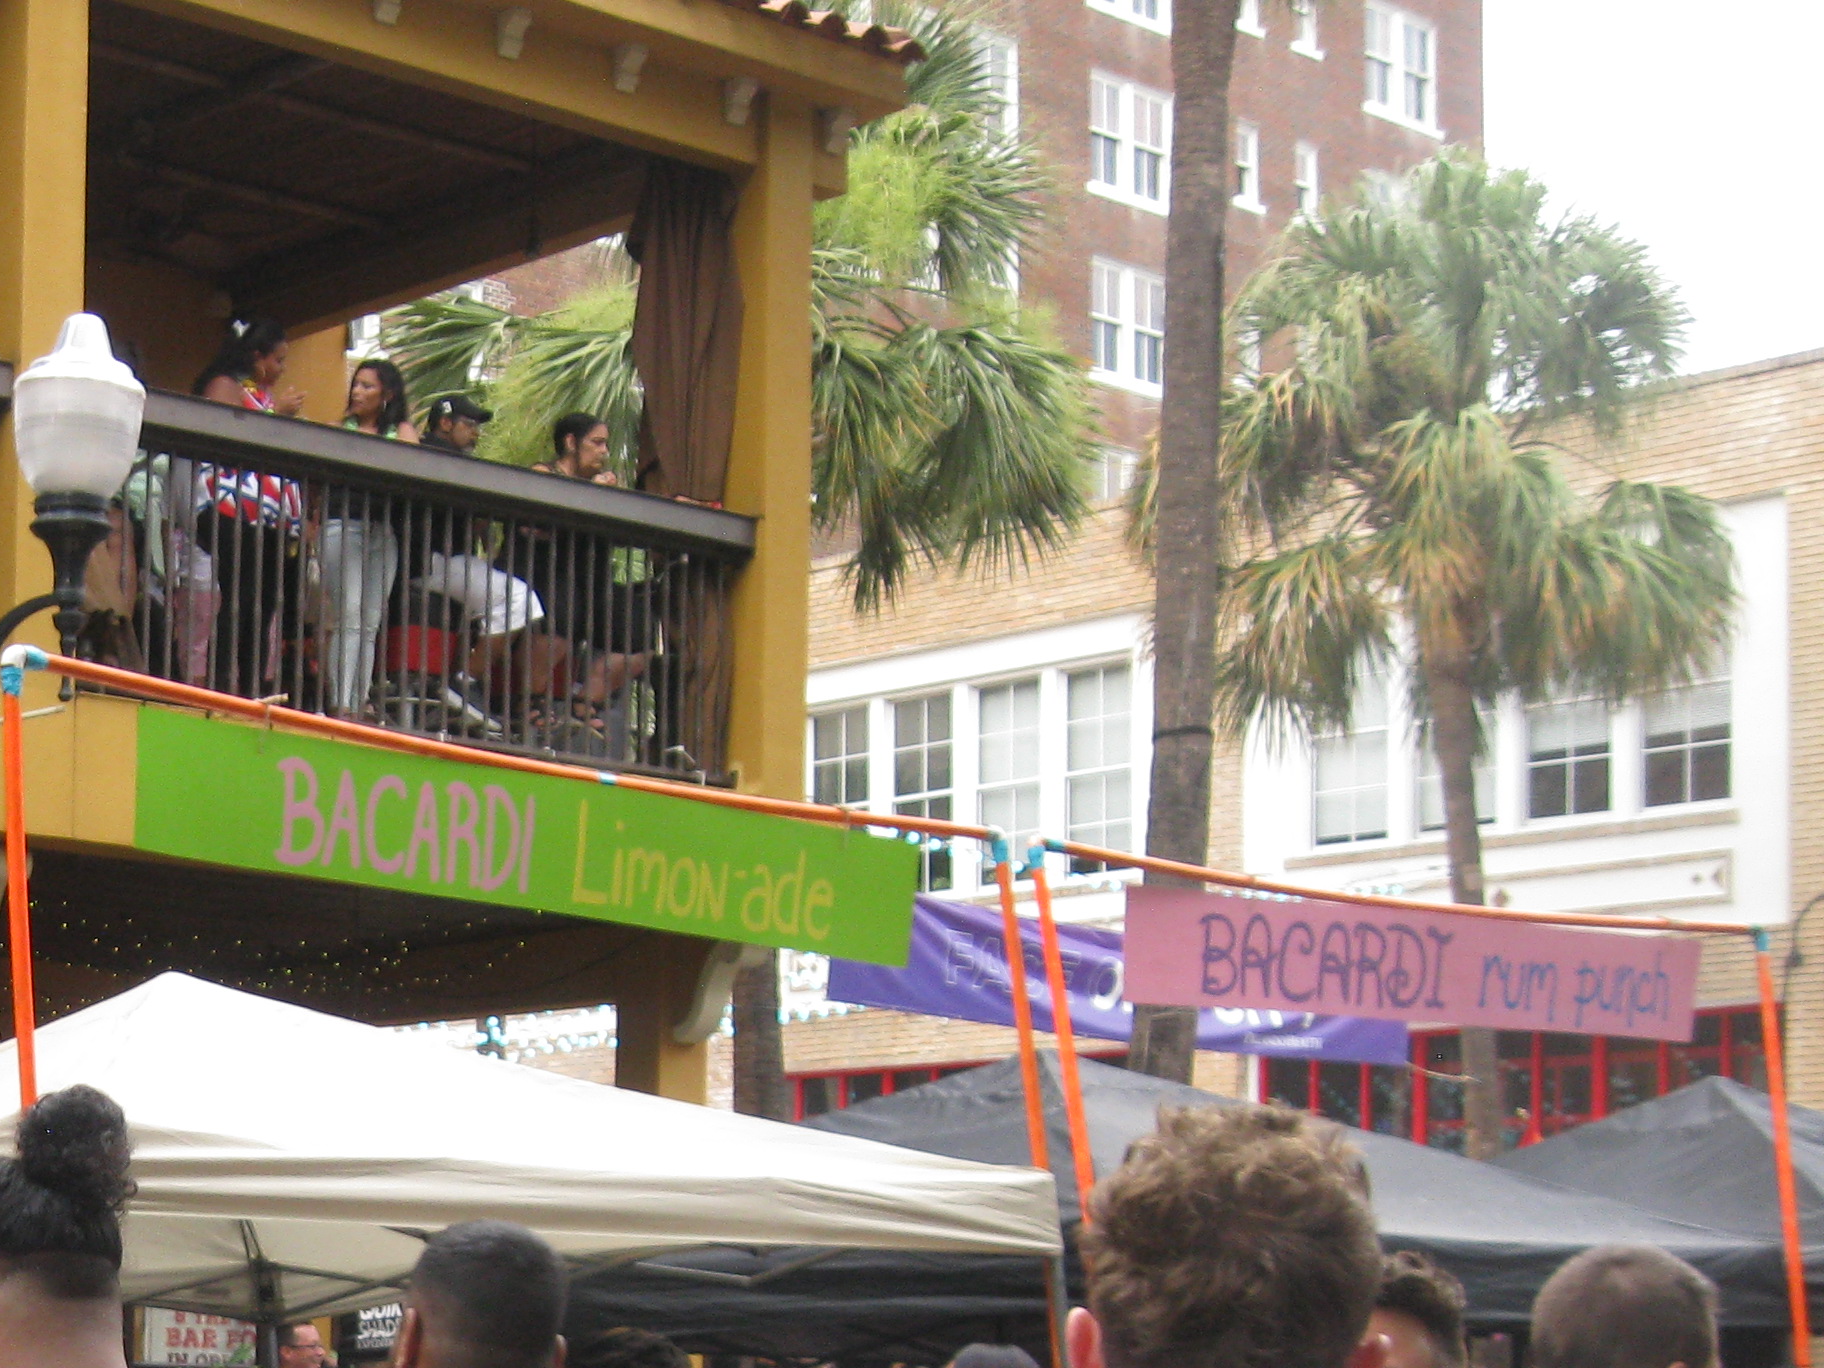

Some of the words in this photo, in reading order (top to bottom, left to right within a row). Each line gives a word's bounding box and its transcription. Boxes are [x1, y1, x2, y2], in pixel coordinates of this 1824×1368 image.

[274, 756, 536, 894] BACARDI
[1199, 912, 1454, 1010] BACARDI
[1478, 953, 1560, 1023] rum
[1573, 950, 1671, 1031] punch
[165, 1327, 216, 1348] BAR
